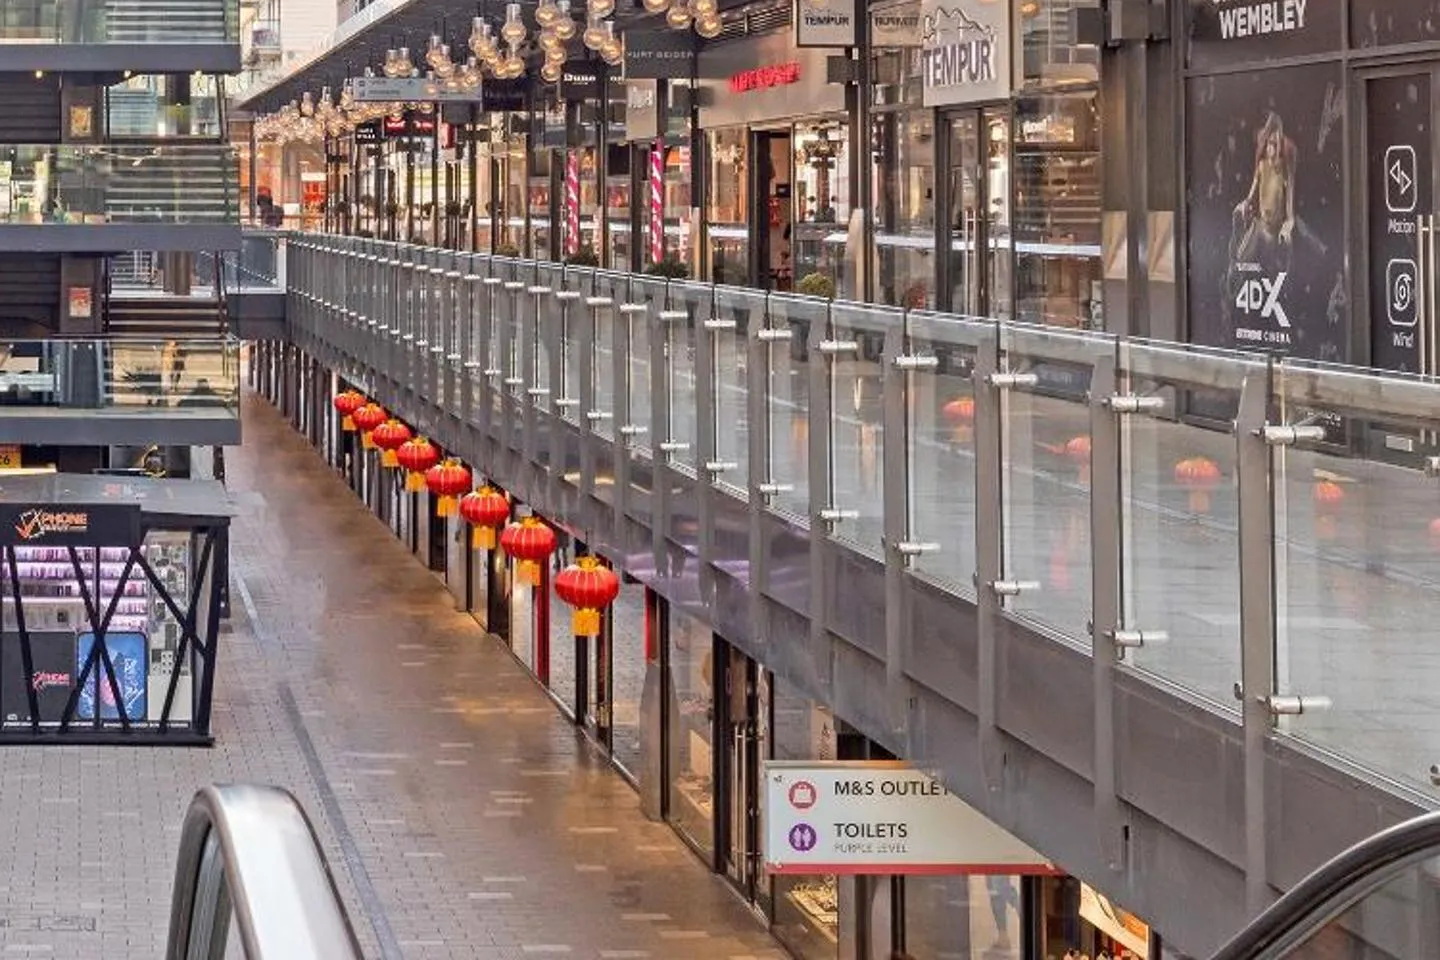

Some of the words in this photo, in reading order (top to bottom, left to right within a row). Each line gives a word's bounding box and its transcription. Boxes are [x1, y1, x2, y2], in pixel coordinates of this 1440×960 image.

[805, 15, 850, 26] TEMPUR
[922, 39, 992, 88] TEMPUR
[1235, 271, 1292, 328] 4DX
[1264, 329, 1292, 344] CINEMA
[1393, 331, 1415, 348] Wind
[834, 781, 874, 796] M&S
[834, 823, 908, 838] TOILETS
[834, 843, 874, 854] PURPLE
[877, 843, 908, 854] LEVEL
